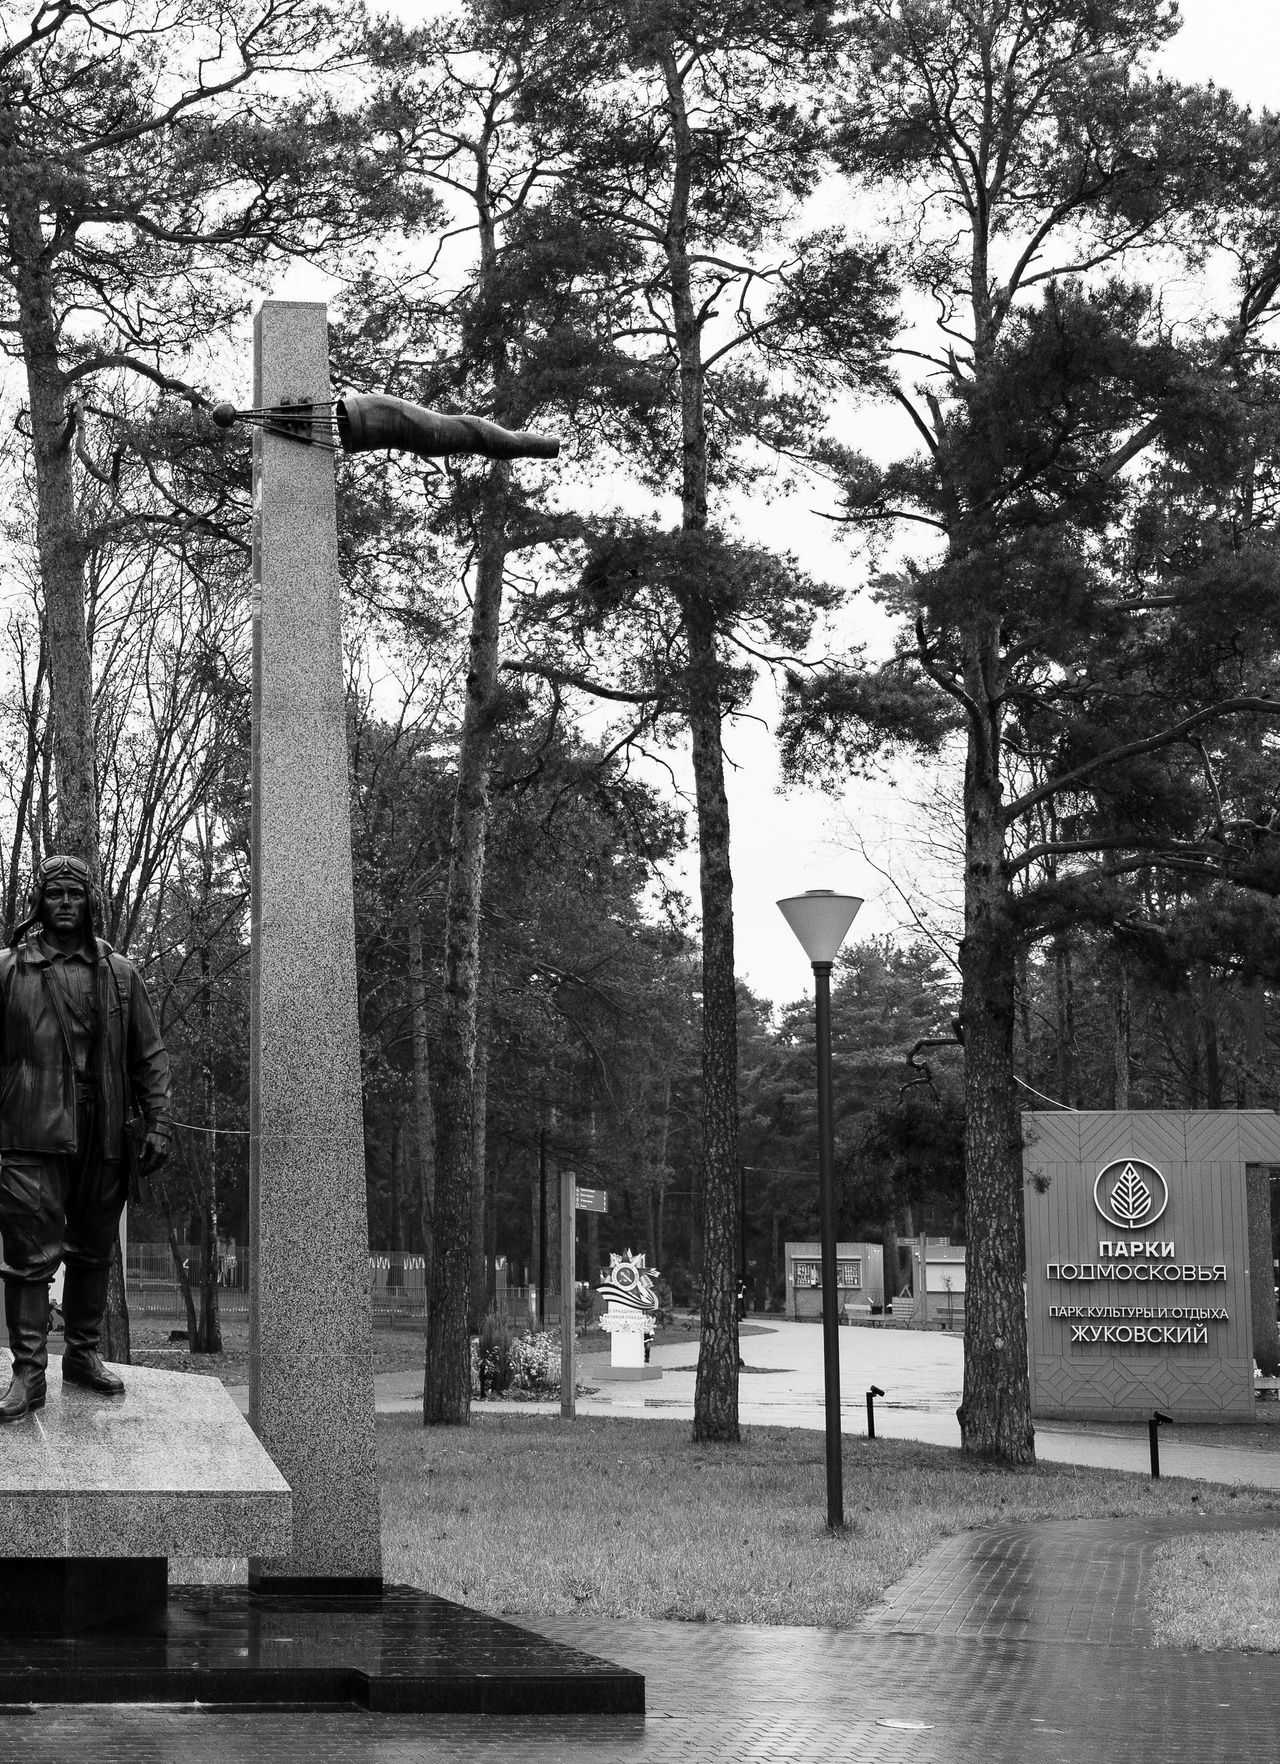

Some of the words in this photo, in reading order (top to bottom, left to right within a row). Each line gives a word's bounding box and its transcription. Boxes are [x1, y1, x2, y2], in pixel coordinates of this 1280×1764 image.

[1099, 1240, 1175, 1258] ПАРКИ
[1046, 1264, 1227, 1281] ПОДМОСКОВЬЯ
[1049, 1306, 1084, 1317] ПАРК
[1087, 1306, 1154, 1318] КУЛЬТУРЫ
[1158, 1307, 1167, 1319] И
[1171, 1307, 1229, 1321] ОТДЫХА
[1070, 1323, 1208, 1344] ЖУКОВСКИЙ
